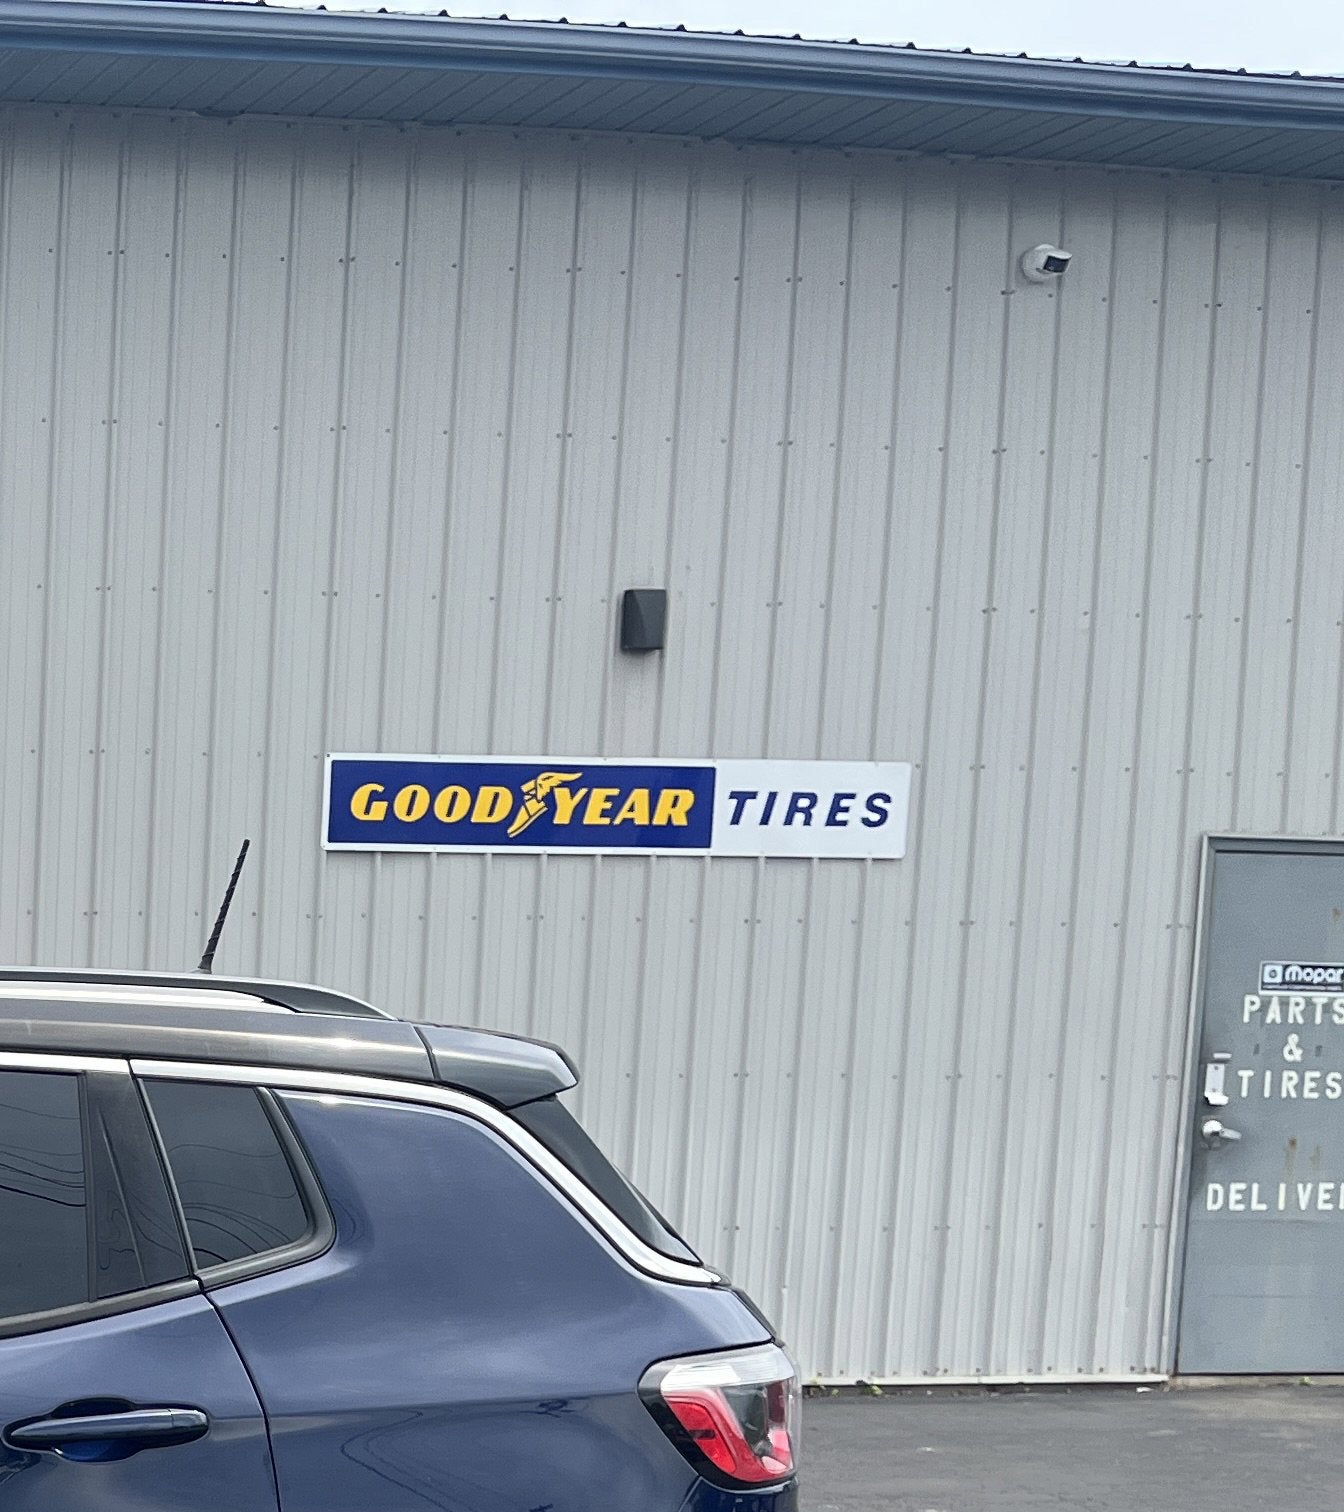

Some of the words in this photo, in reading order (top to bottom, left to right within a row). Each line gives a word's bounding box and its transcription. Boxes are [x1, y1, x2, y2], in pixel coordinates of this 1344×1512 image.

[727, 789, 893, 828] TIRES
[1242, 995, 1344, 1025] PARTS
[1282, 1033, 1304, 1063] &
[1237, 1069, 1343, 1100] TIRES
